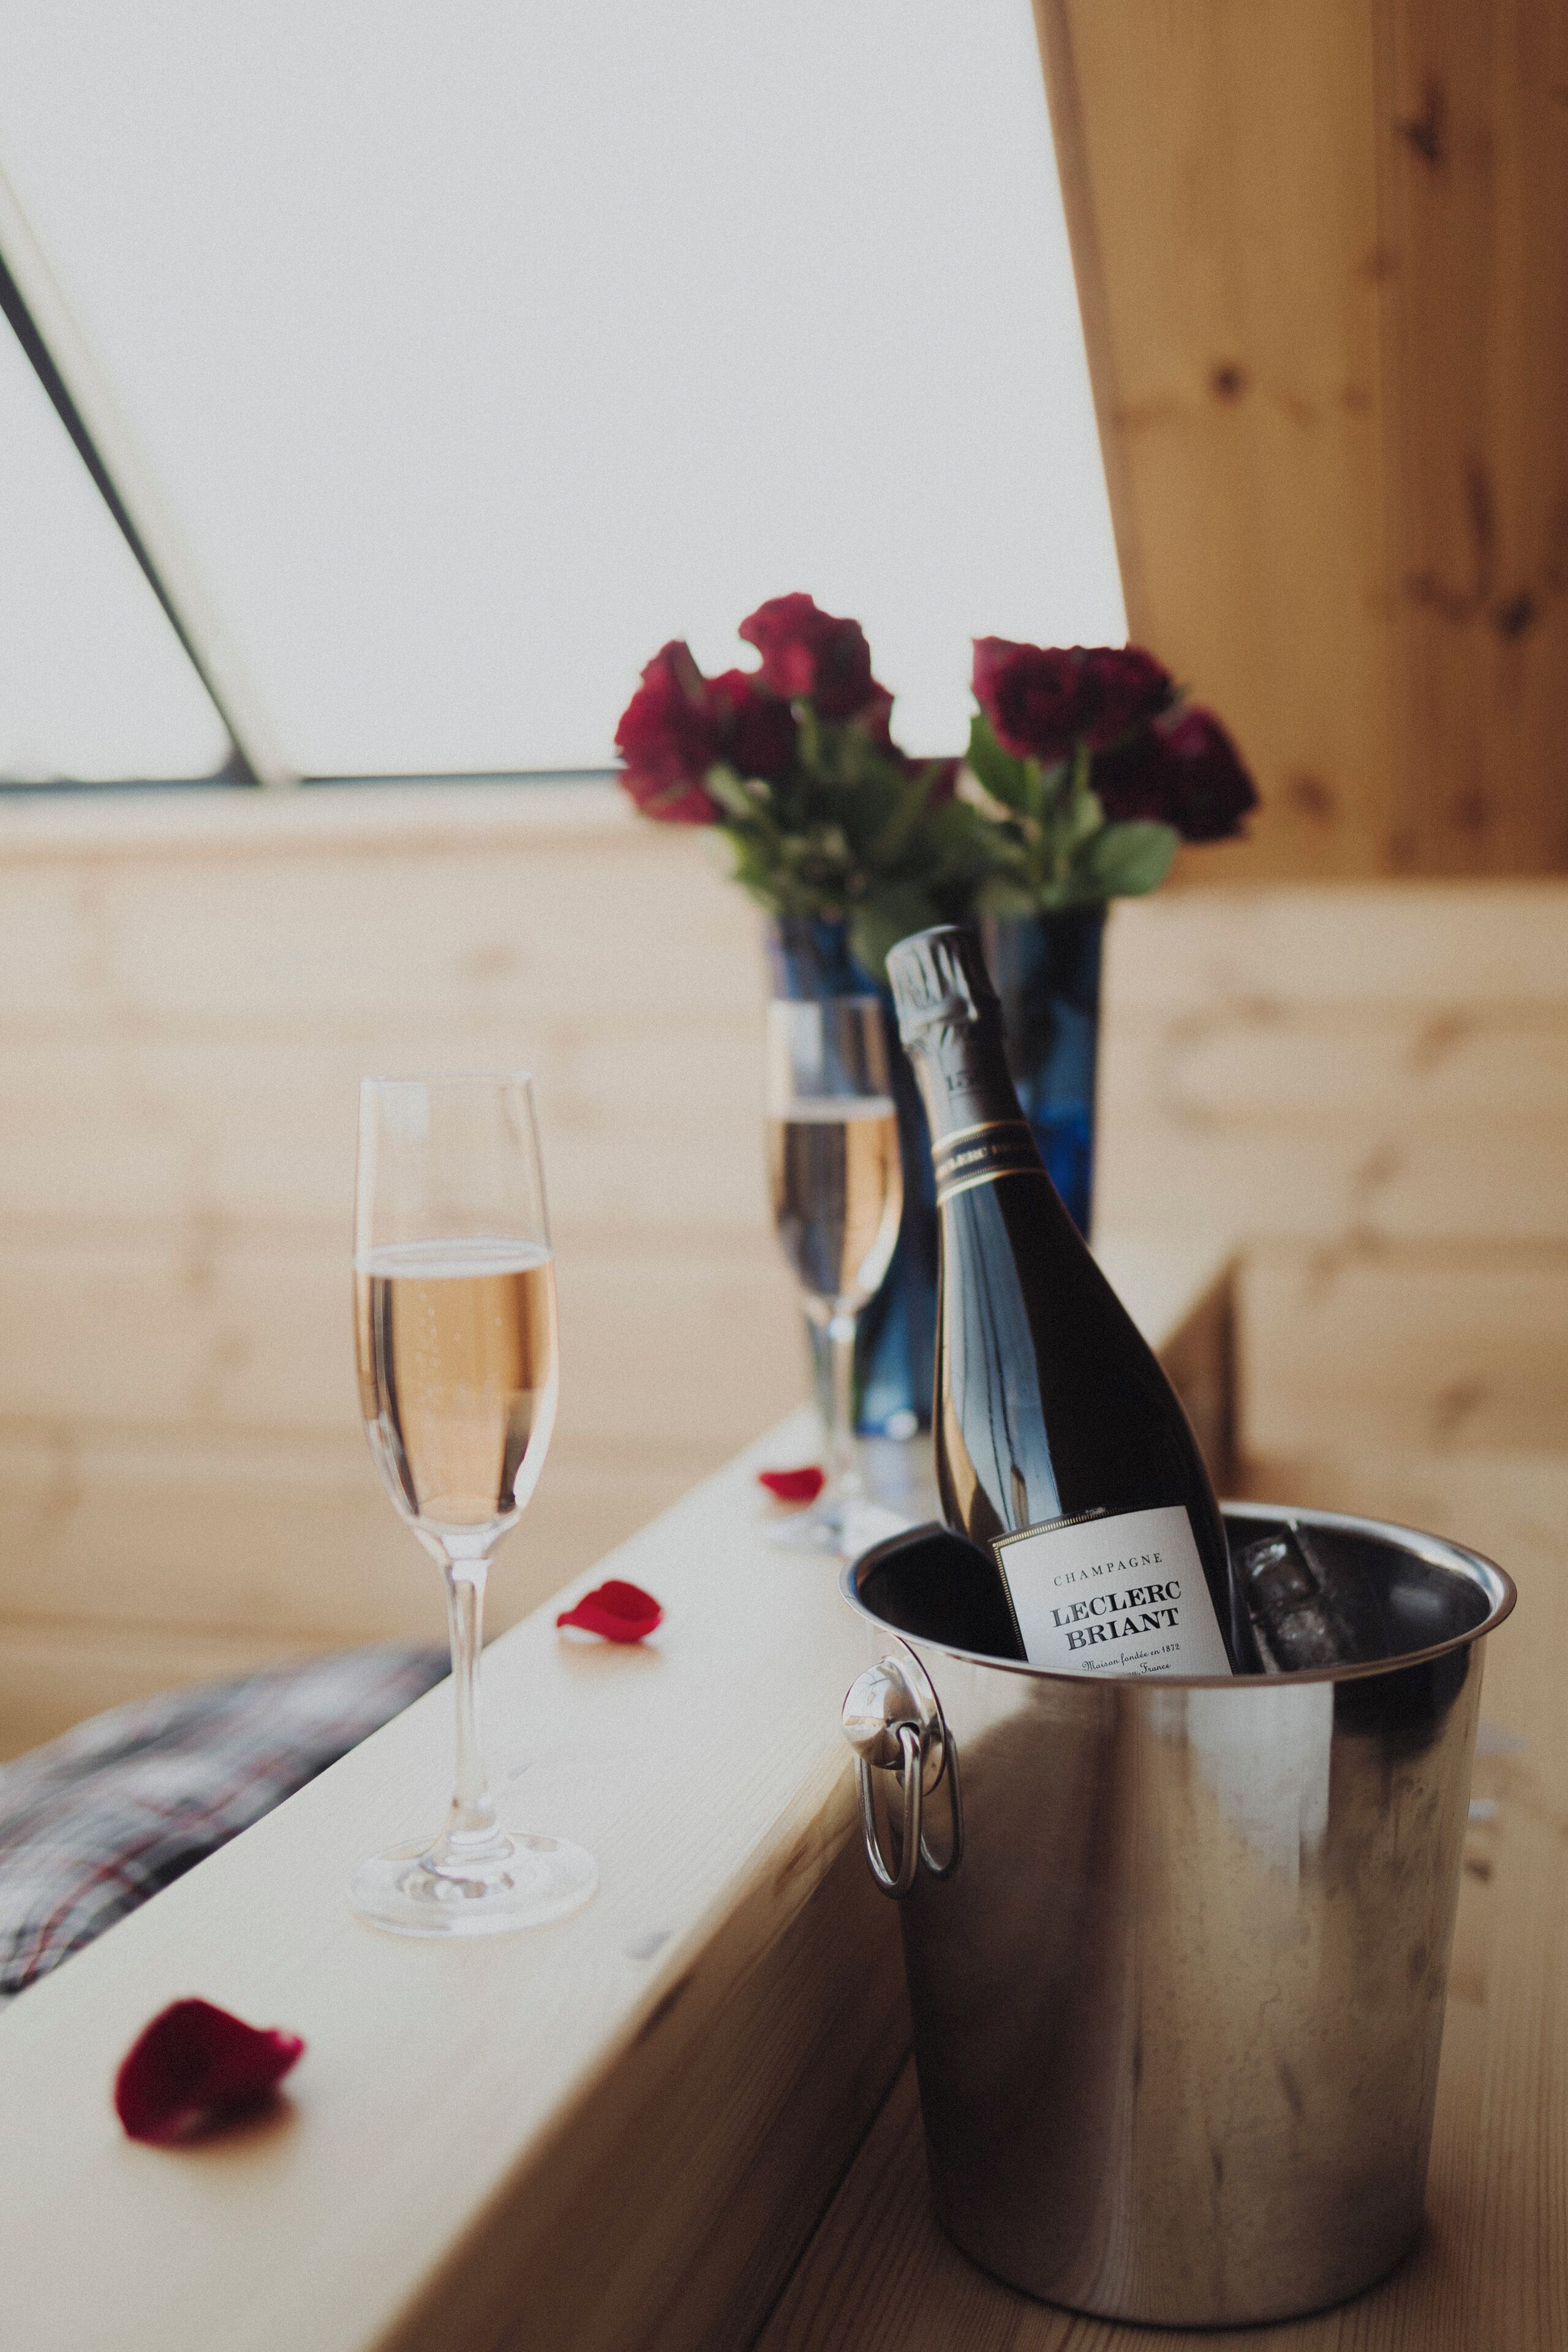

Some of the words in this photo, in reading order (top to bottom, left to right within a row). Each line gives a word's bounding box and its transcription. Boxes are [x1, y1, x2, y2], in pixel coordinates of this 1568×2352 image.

[1054, 1552, 1163, 1586] CHAMPAGNE
[1050, 1580, 1182, 1628] LECLERC
[1065, 1607, 1180, 1651] BRIANT
[1082, 1659, 1120, 1672] Maison
[1120, 1651, 1150, 1667] fondée
[1161, 1643, 1181, 1654] 1872
[1139, 1662, 1172, 1675] France
